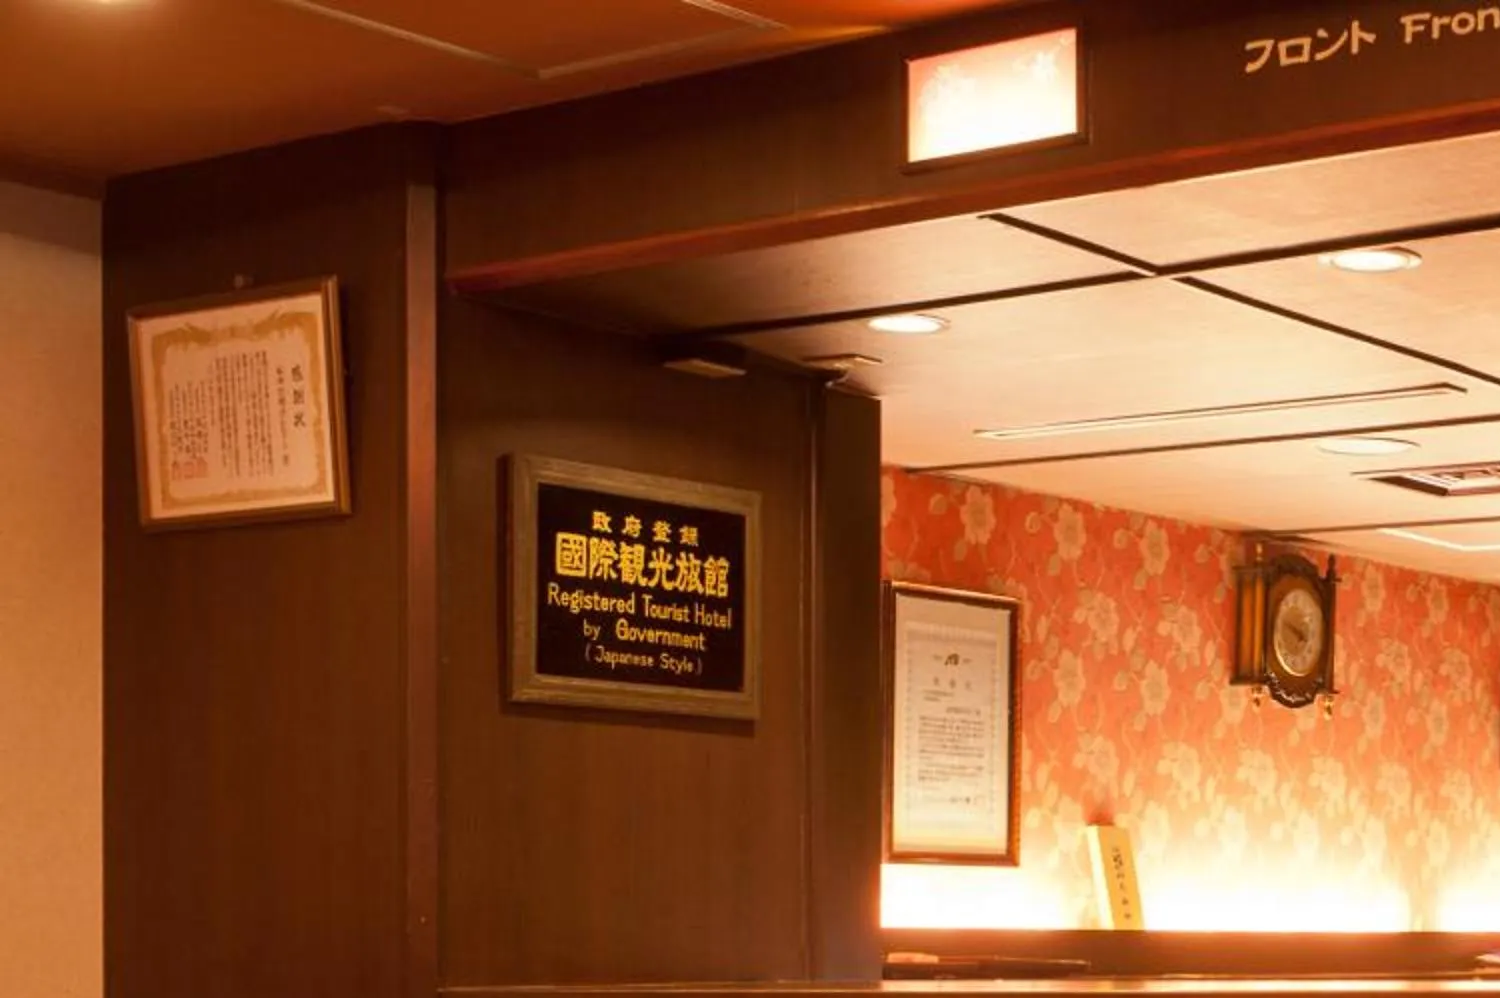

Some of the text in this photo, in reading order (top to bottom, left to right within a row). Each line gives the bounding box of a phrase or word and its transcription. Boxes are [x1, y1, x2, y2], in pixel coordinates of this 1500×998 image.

[1245, 20, 1376, 73] フロント
[547, 582, 732, 630] Registered Tourist Hotel
[583, 618, 706, 651] by Government
